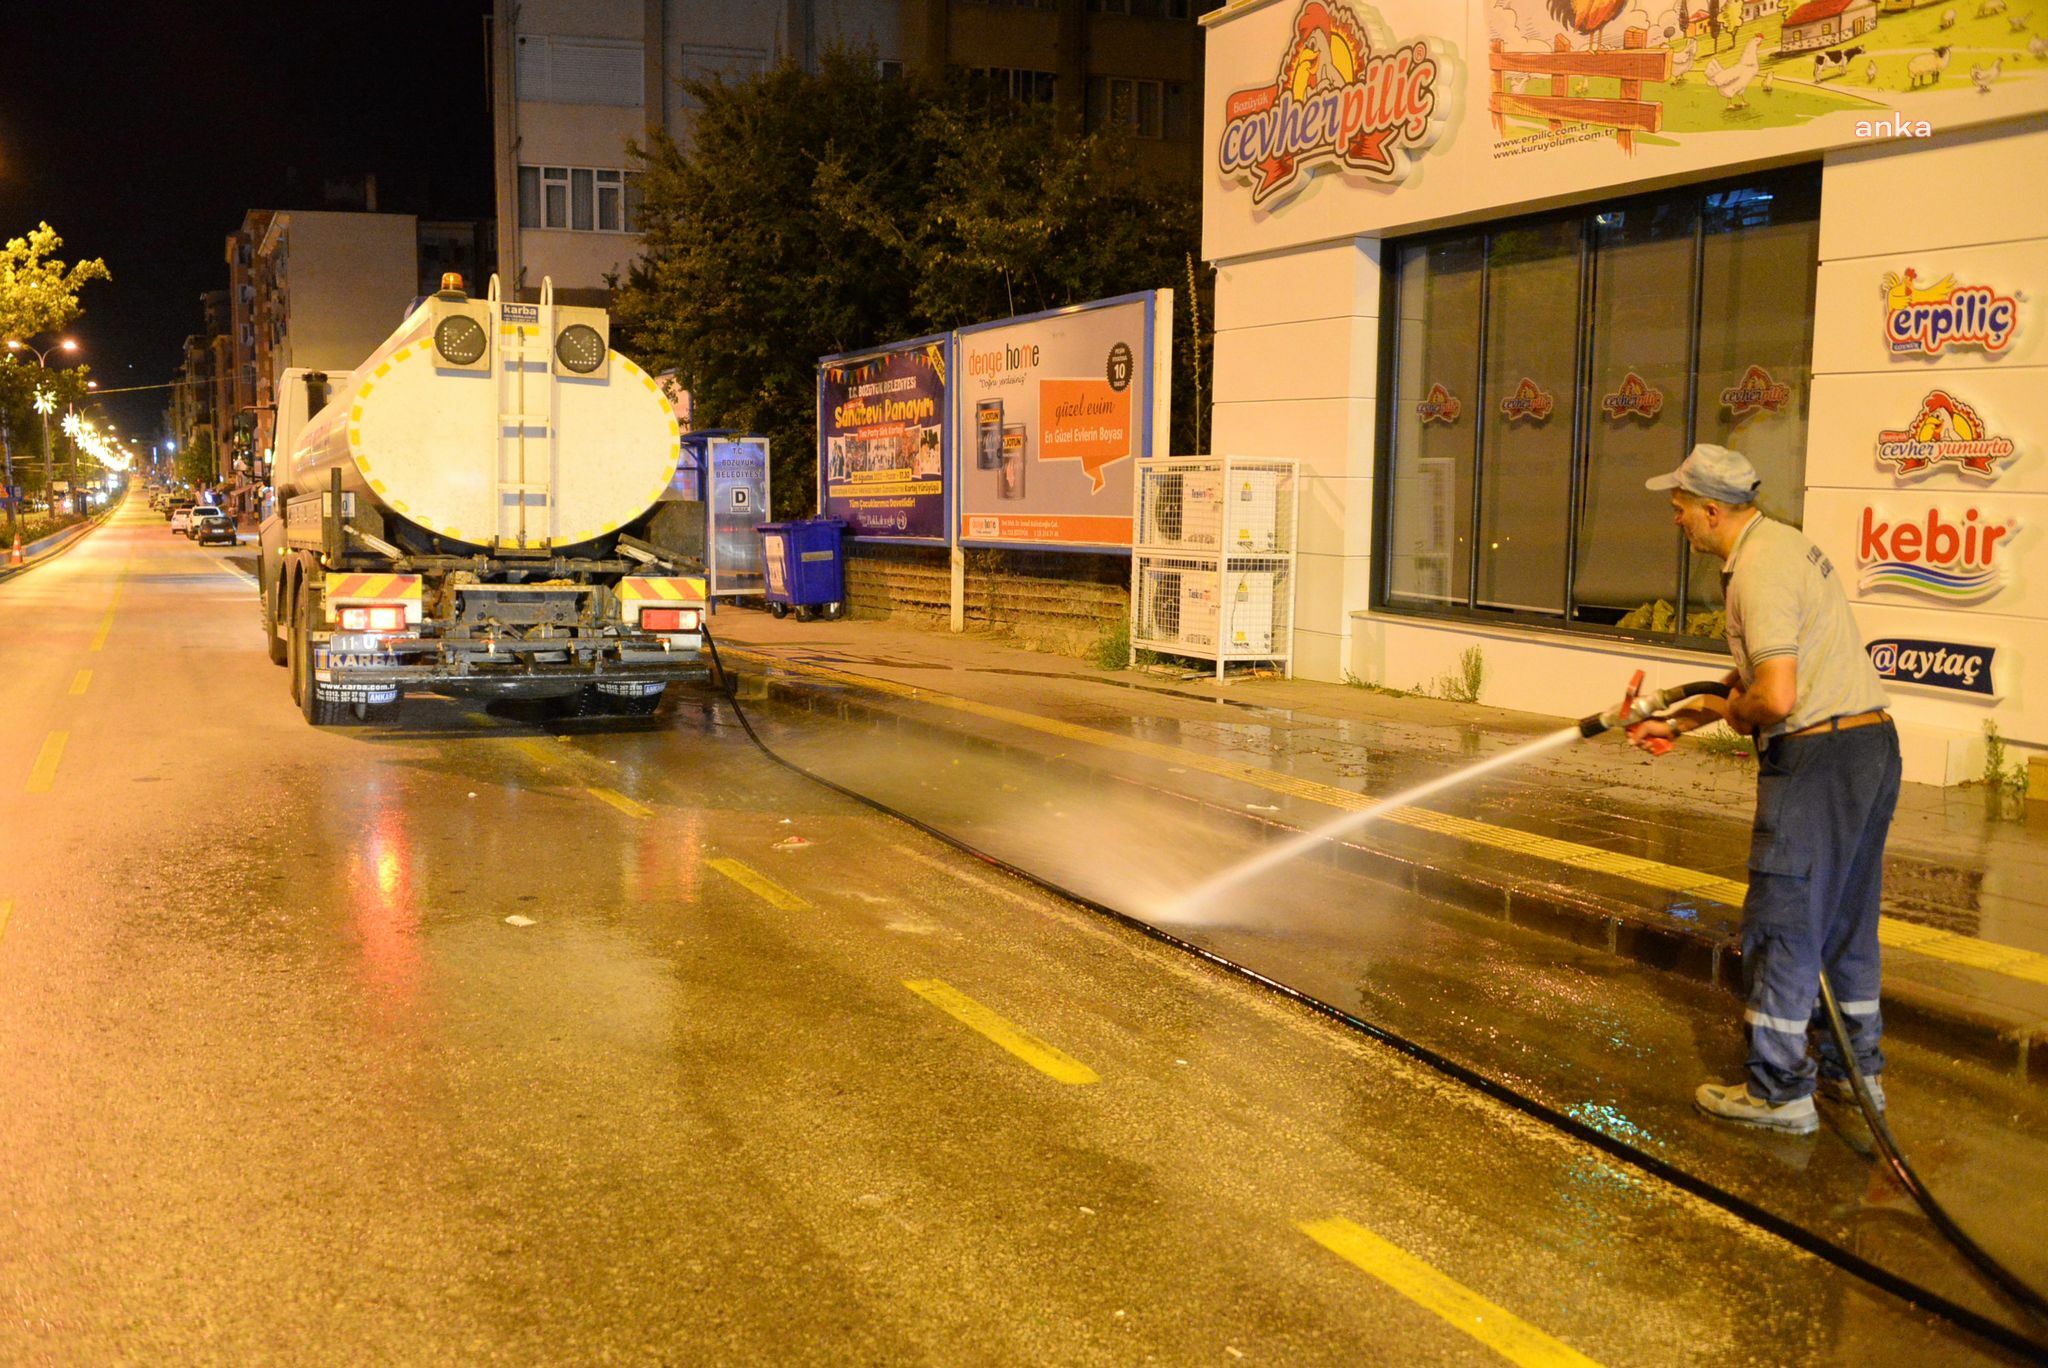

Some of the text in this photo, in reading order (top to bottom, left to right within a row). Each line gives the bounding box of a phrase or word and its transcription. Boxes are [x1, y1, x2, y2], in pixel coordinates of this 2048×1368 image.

[1223, 56, 1431, 165] cevherpiliç
[1233, 93, 1269, 114] Bozüyük
[1492, 127, 1615, 160] www.kuruyolum.com.tr
[1493, 122, 1590, 149] www.erpilic.com.tr
[503, 303, 537, 315] karba
[1893, 294, 2010, 345] erpiliç
[968, 349, 1003, 379] denge
[1005, 342, 1040, 371] home
[1114, 362, 1126, 379] 10
[1055, 393, 1115, 426] güzel evim
[1045, 426, 1123, 444] En Güzel Evlerin Boyası
[735, 491, 746, 504] D
[1861, 506, 2006, 565] kebir
[330, 653, 399, 668] KARBA
[320, 683, 396, 691] www.karba.com.tr
